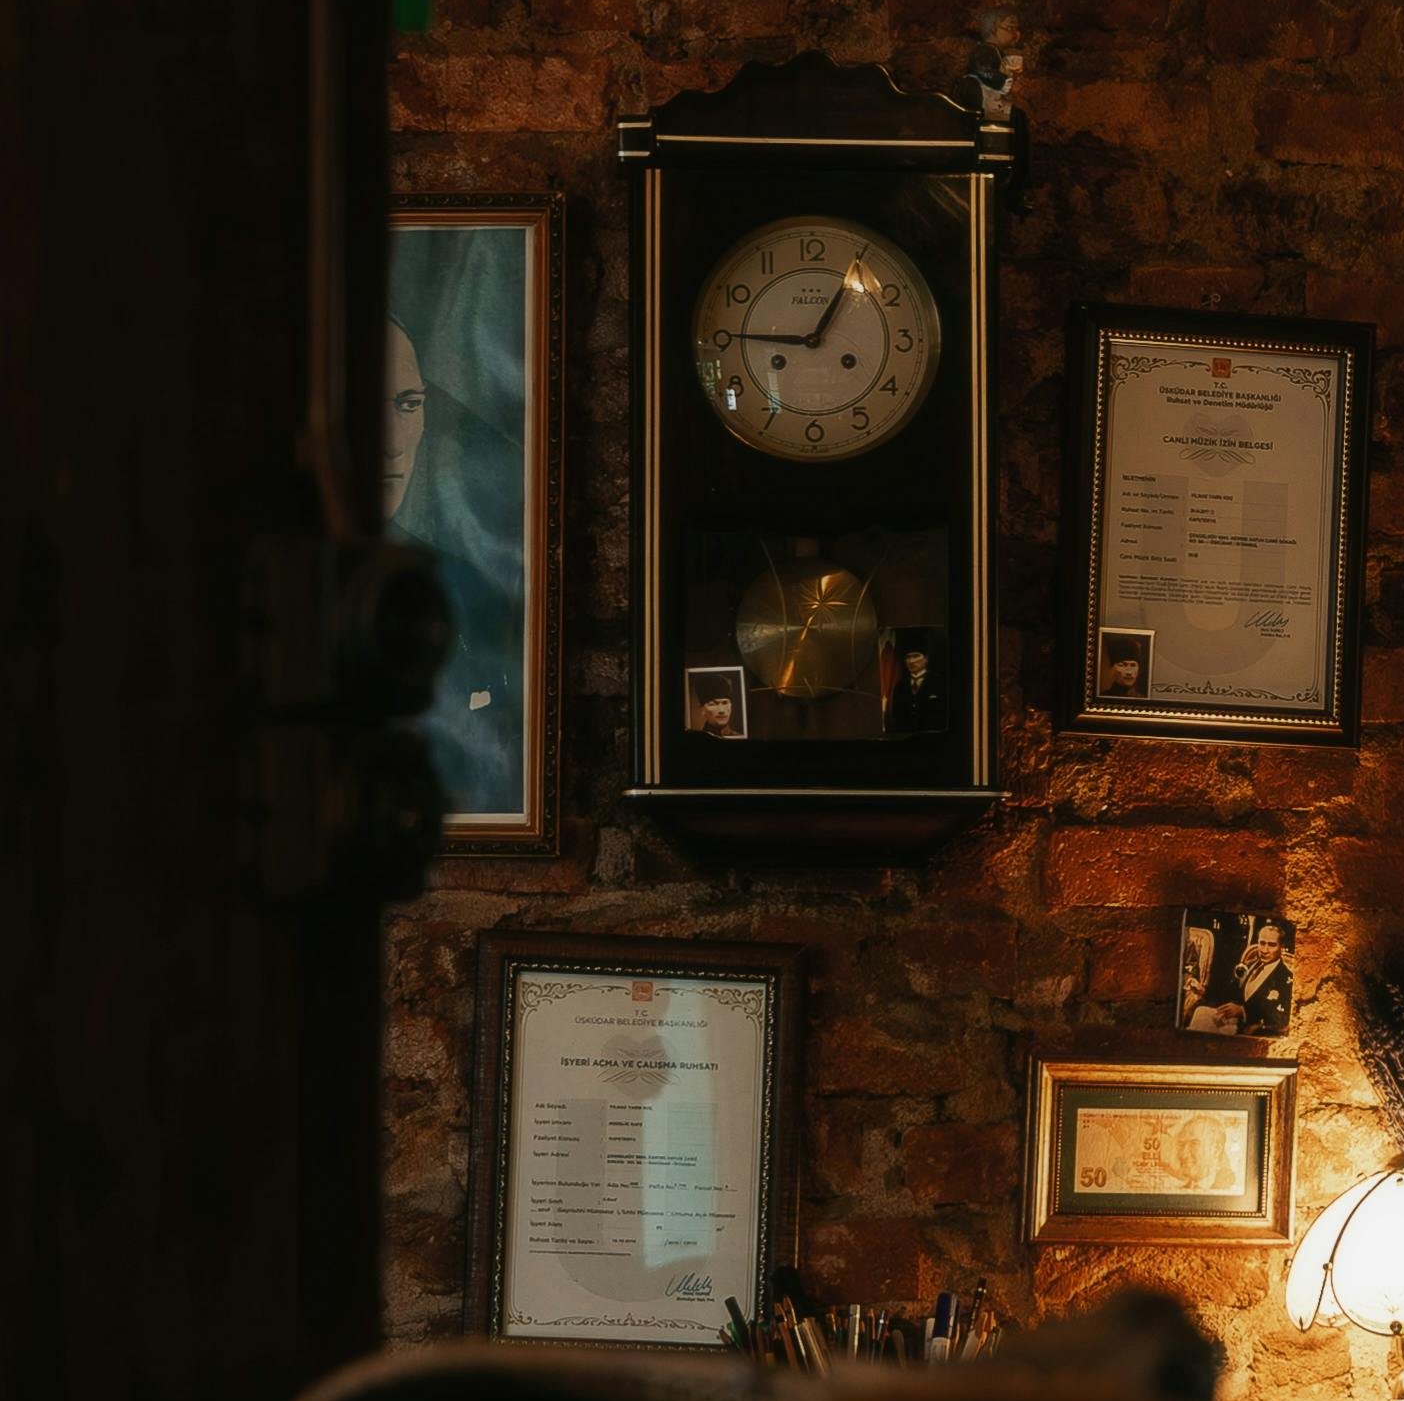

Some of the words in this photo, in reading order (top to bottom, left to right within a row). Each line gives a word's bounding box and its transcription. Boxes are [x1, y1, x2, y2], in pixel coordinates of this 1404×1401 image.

[799, 238, 825, 262] 12
[760, 250, 774, 275] 11
[724, 283, 751, 308] 10
[791, 295, 829, 305] FALCON
[882, 284, 901, 307] 2
[713, 328, 732, 352] 9
[894, 328, 913, 353] 3
[727, 375, 744, 397] 8
[879, 374, 898, 396] 4
[1159, 386, 1195, 396] ÜSKÜDAR
[1197, 389, 1234, 399] BELEDİYE
[1236, 391, 1282, 402] BAŞKANLIĞI
[761, 407, 779, 431] 7
[805, 418, 825, 443] 6
[851, 407, 869, 431] 5
[1162, 436, 1189, 445] CANLI
[1191, 436, 1217, 447] MÜZİK
[1219, 438, 1237, 447] İZİN
[1238, 441, 1273, 450] BELGESİ
[560, 1056, 590, 1067] İŞYERİ
[592, 1059, 619, 1069] AÇMA
[621, 1060, 634, 1068] VE
[636, 1060, 677, 1070] ÇALIŞMA
[679, 1062, 719, 1071] RUHSATI
[1144, 1137, 1160, 1151] 50
[1080, 1166, 1107, 1188] 50
